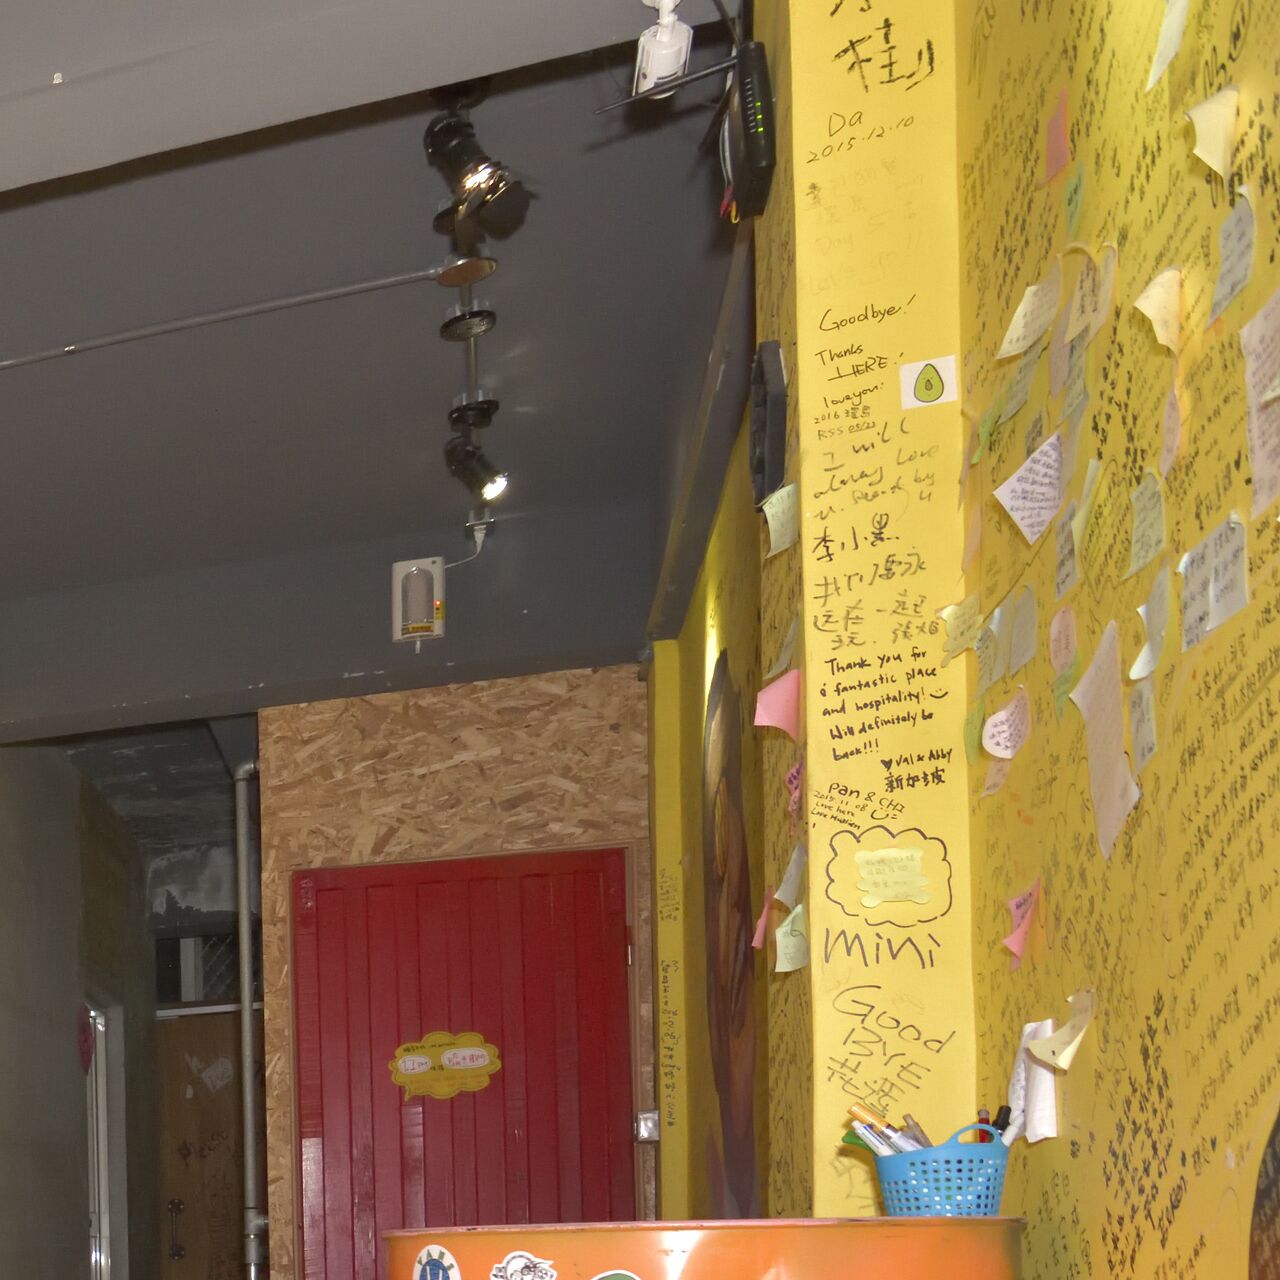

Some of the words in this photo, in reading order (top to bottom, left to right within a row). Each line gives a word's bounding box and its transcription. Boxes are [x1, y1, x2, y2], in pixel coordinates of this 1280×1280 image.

[824, 657, 871, 676] Thank
[877, 654, 903, 668] you
[911, 646, 927, 661] for
[834, 673, 897, 696] fantastic
[906, 667, 937, 685] place
[822, 698, 846, 717] and
[855, 686, 926, 712] hospitality!
[830, 725, 855, 740] Will
[858, 711, 918, 735] definitely
[921, 708, 934, 720] be
[928, 748, 953, 763] Abby
[885, 766, 946, 793] 新加坡
[864, 791, 876, 803] &
